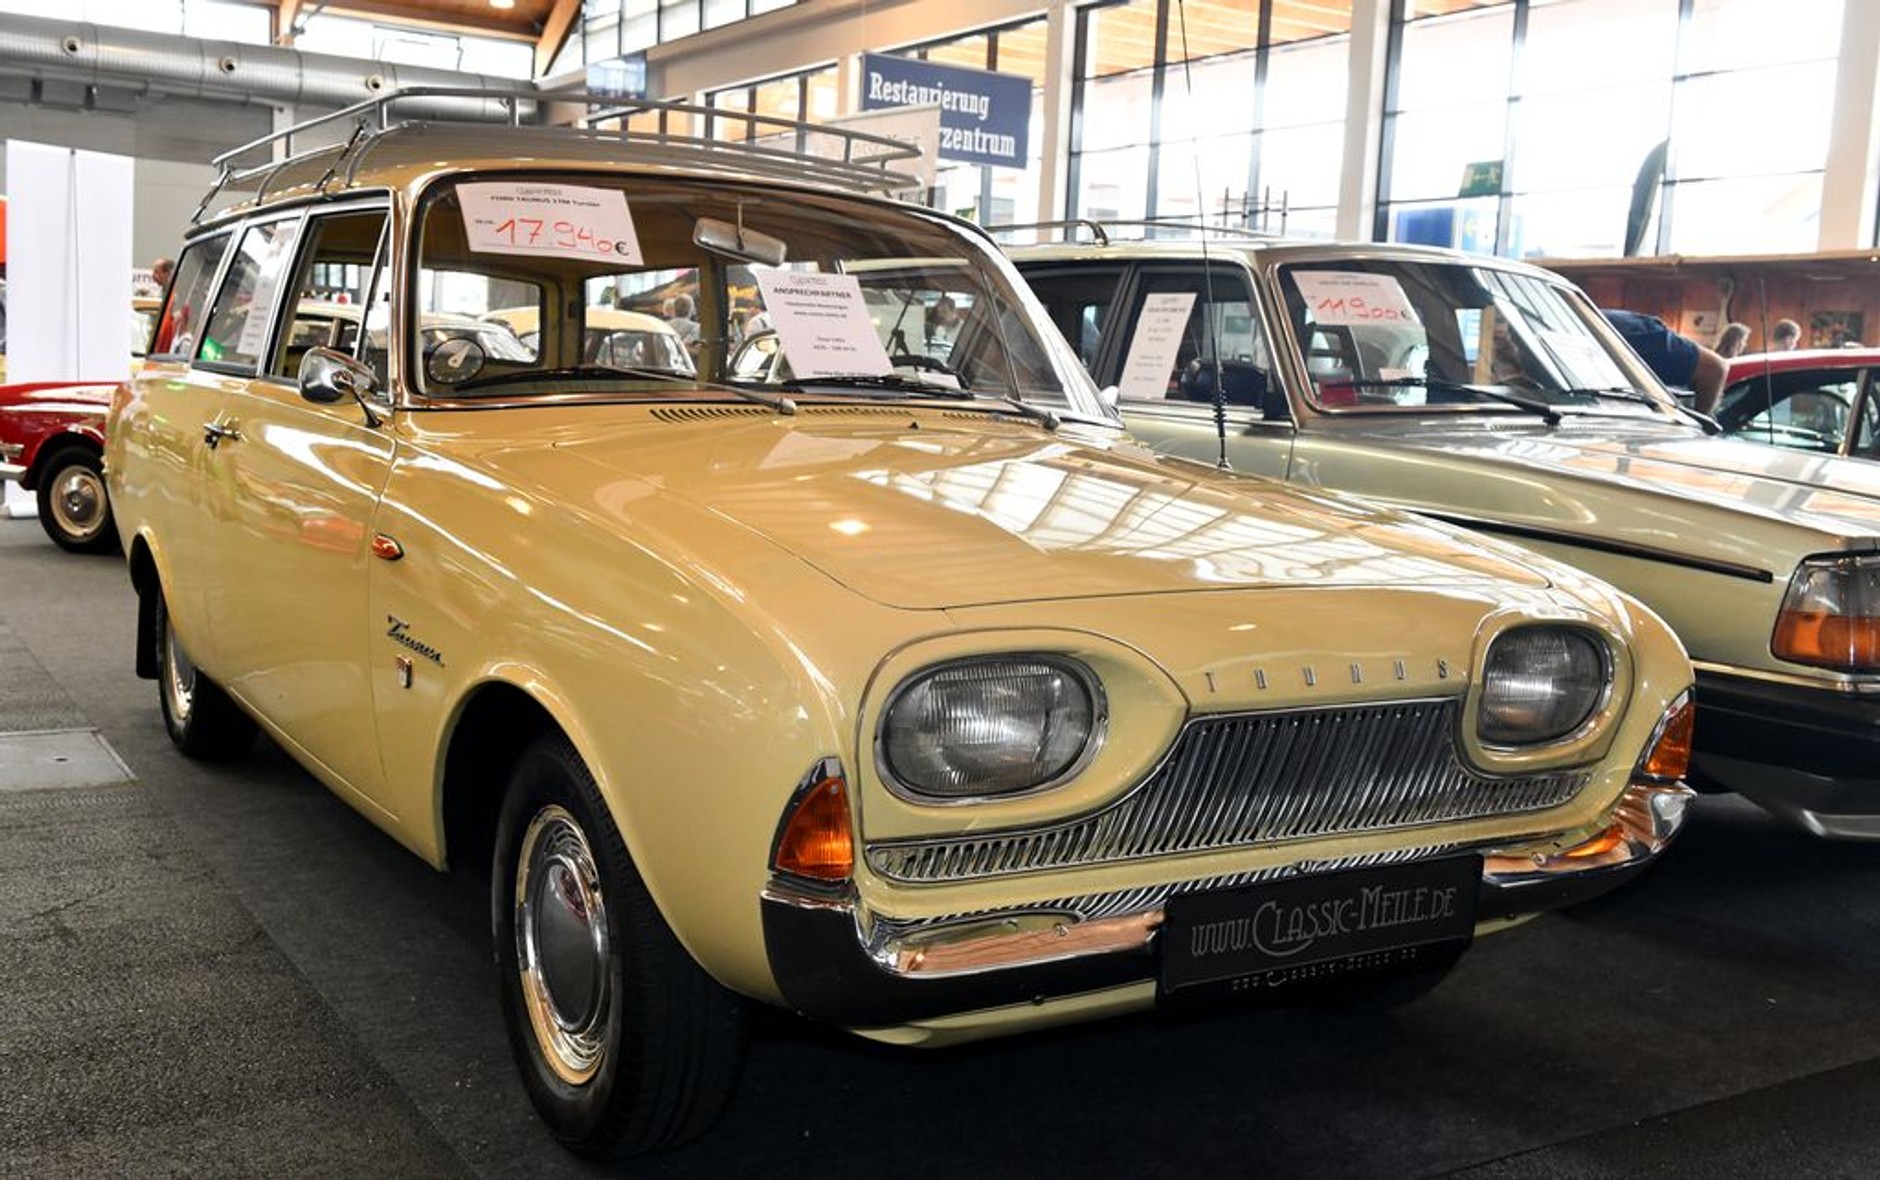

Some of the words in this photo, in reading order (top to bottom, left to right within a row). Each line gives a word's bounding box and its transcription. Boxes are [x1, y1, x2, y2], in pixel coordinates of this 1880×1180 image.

[868, 71, 990, 120] Restaurierung
[773, 286, 852, 299] ANSPRECHPARTNER
[386, 614, 445, 668] Taunus
